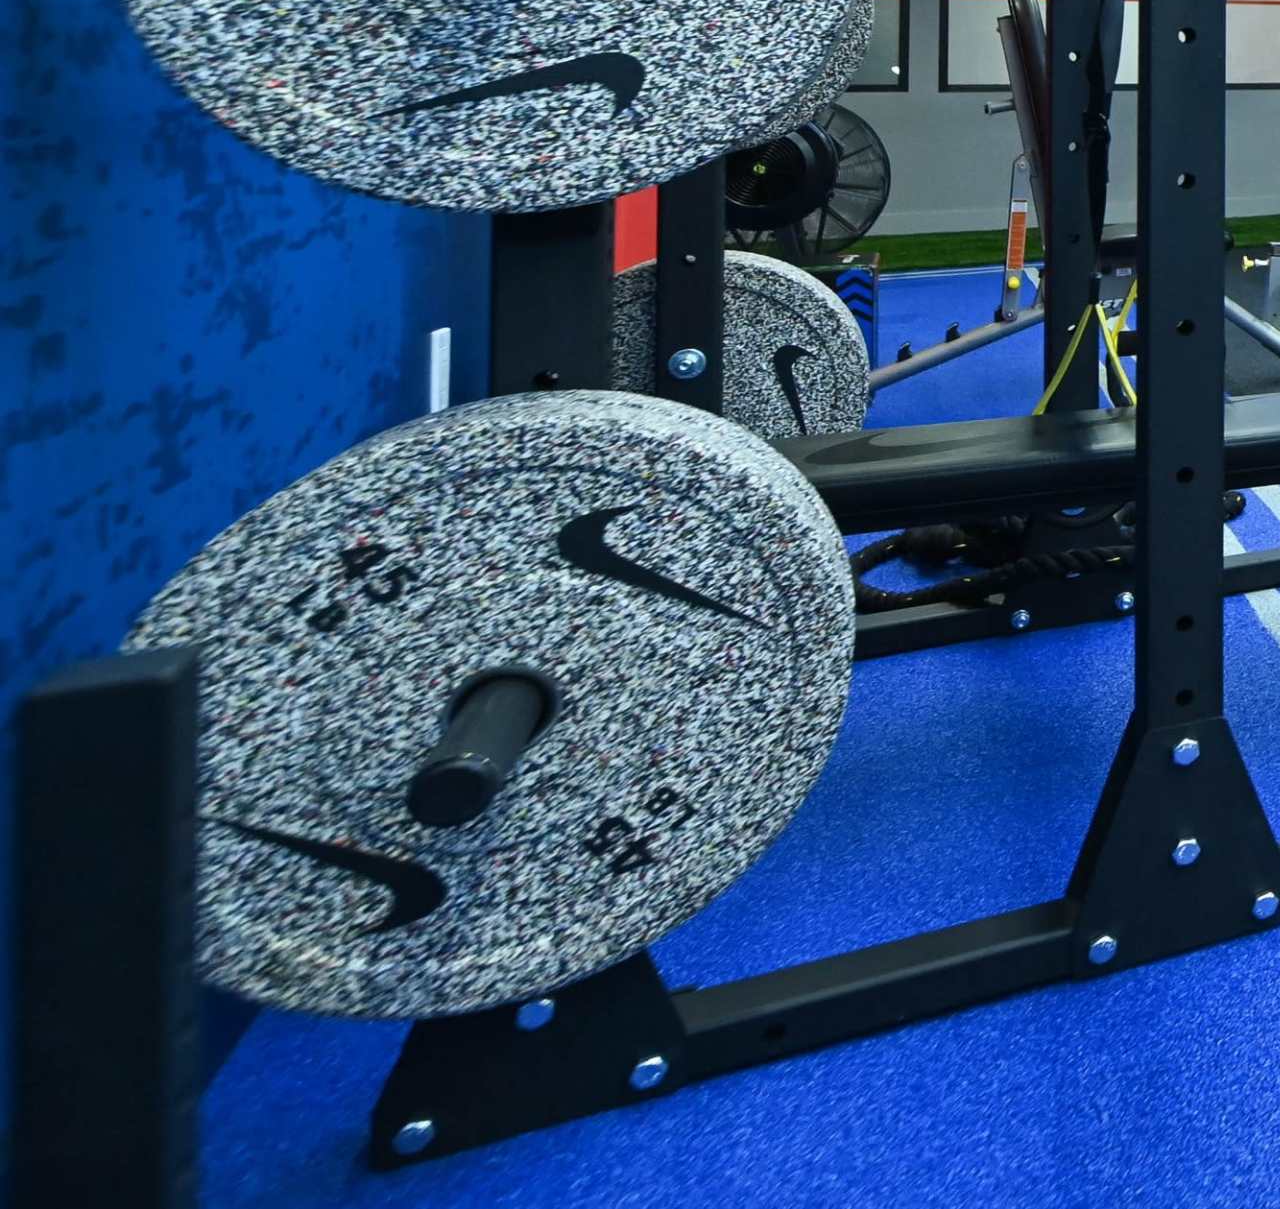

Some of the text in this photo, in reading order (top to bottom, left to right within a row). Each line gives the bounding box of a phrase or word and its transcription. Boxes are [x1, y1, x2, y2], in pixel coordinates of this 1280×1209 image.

[339, 544, 417, 605] 45
[643, 785, 695, 830] LB
[582, 816, 657, 874] 45
